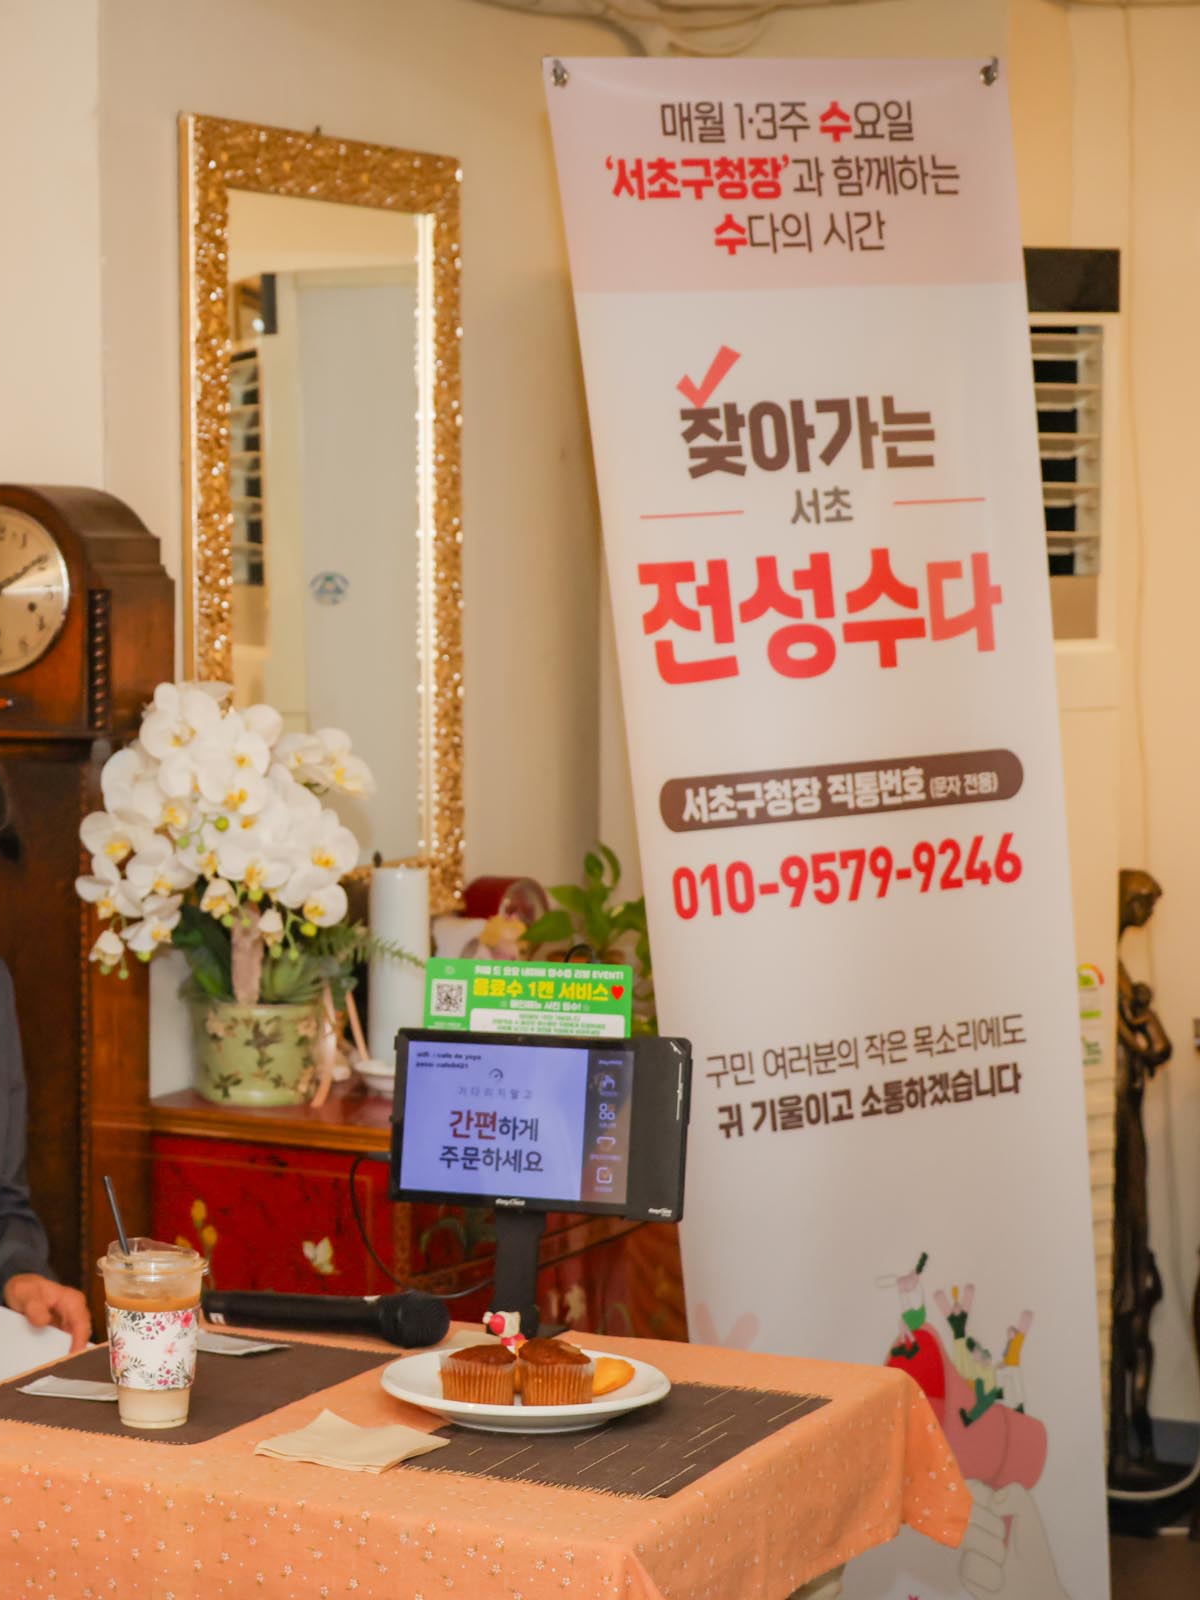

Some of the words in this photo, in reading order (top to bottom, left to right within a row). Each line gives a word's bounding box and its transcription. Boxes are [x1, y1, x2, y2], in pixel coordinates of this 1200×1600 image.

[660, 101, 726, 143] 매월
[818, 100, 915, 143] 수요일
[832, 154, 960, 197] 함께하는
[714, 212, 813, 256] 수다의
[823, 210, 886, 252] 시간
[680, 395, 936, 480] 찾아가는
[790, 486, 854, 525] 서초
[637, 547, 1003, 686] 전성수다
[682, 777, 822, 823] 서초구청장
[827, 766, 927, 810] 직통번호
[671, 832, 1023, 920] 010-9579-9246
[473, 978, 523, 998] 음료수
[528, 981, 554, 999] 1캔
[558, 982, 609, 1001] 서비스
[704, 1051, 755, 1089] 구민
[762, 1038, 859, 1082] 여러분의
[865, 1028, 909, 1066] 작은
[913, 1013, 1027, 1058] 목소리에도
[717, 1103, 744, 1139] 귀
[751, 1088, 854, 1134] 기울이고
[861, 1061, 1022, 1118] 소통하겠습니다
[449, 1109, 539, 1142] 간편하게
[439, 1146, 544, 1174] 주문하세요
